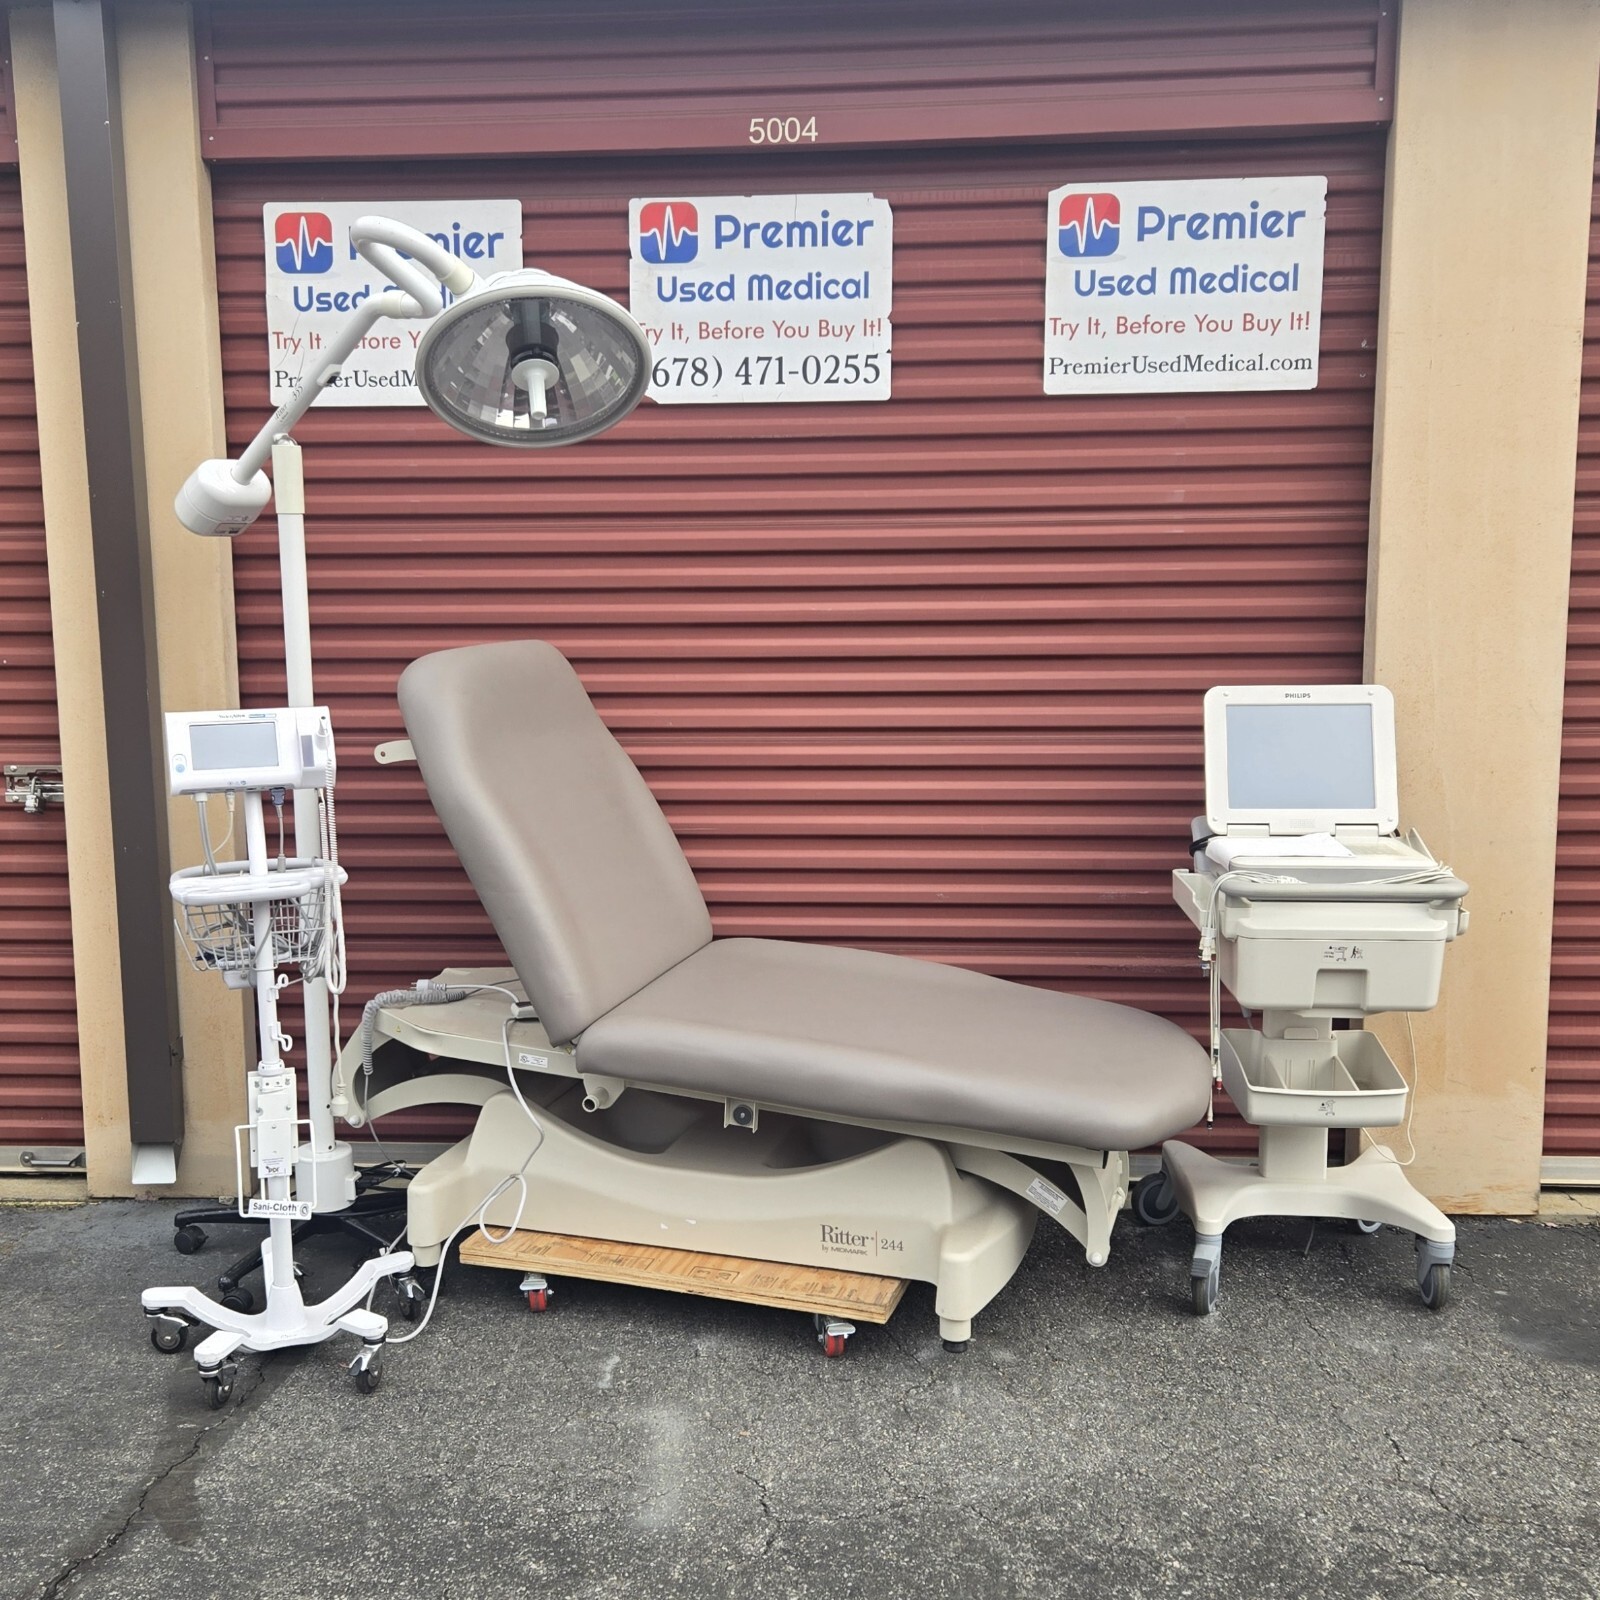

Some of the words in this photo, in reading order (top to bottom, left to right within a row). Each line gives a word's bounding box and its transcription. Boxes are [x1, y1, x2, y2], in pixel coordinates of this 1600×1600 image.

[749, 116, 818, 144] 5004
[714, 209, 874, 249] Premier
[1137, 200, 1306, 242] Premier
[657, 274, 735, 302] Used
[748, 271, 869, 301] Medical
[1074, 267, 1157, 297] Used
[1169, 263, 1299, 295] Medical
[671, 322, 689, 343] It,
[699, 320, 765, 340] Before
[772, 320, 809, 338] You
[818, 319, 855, 342] Buy
[863, 318, 882, 336] It!
[1049, 317, 1079, 341] Try
[1087, 316, 1107, 338] It,
[1116, 314, 1186, 334] Before
[1195, 314, 1233, 333] You
[1242, 313, 1281, 336] Buy
[1290, 311, 1310, 331] It!
[272, 331, 301, 355] Try
[734, 353, 881, 386] 471-0255
[1049, 353, 1313, 376] PremierUsedMedical.com
[253, 1202, 297, 1212] Sani-Cloth
[820, 1224, 869, 1247] Ritter
[881, 1238, 904, 1252] 244
[822, 1244, 829, 1253] by
